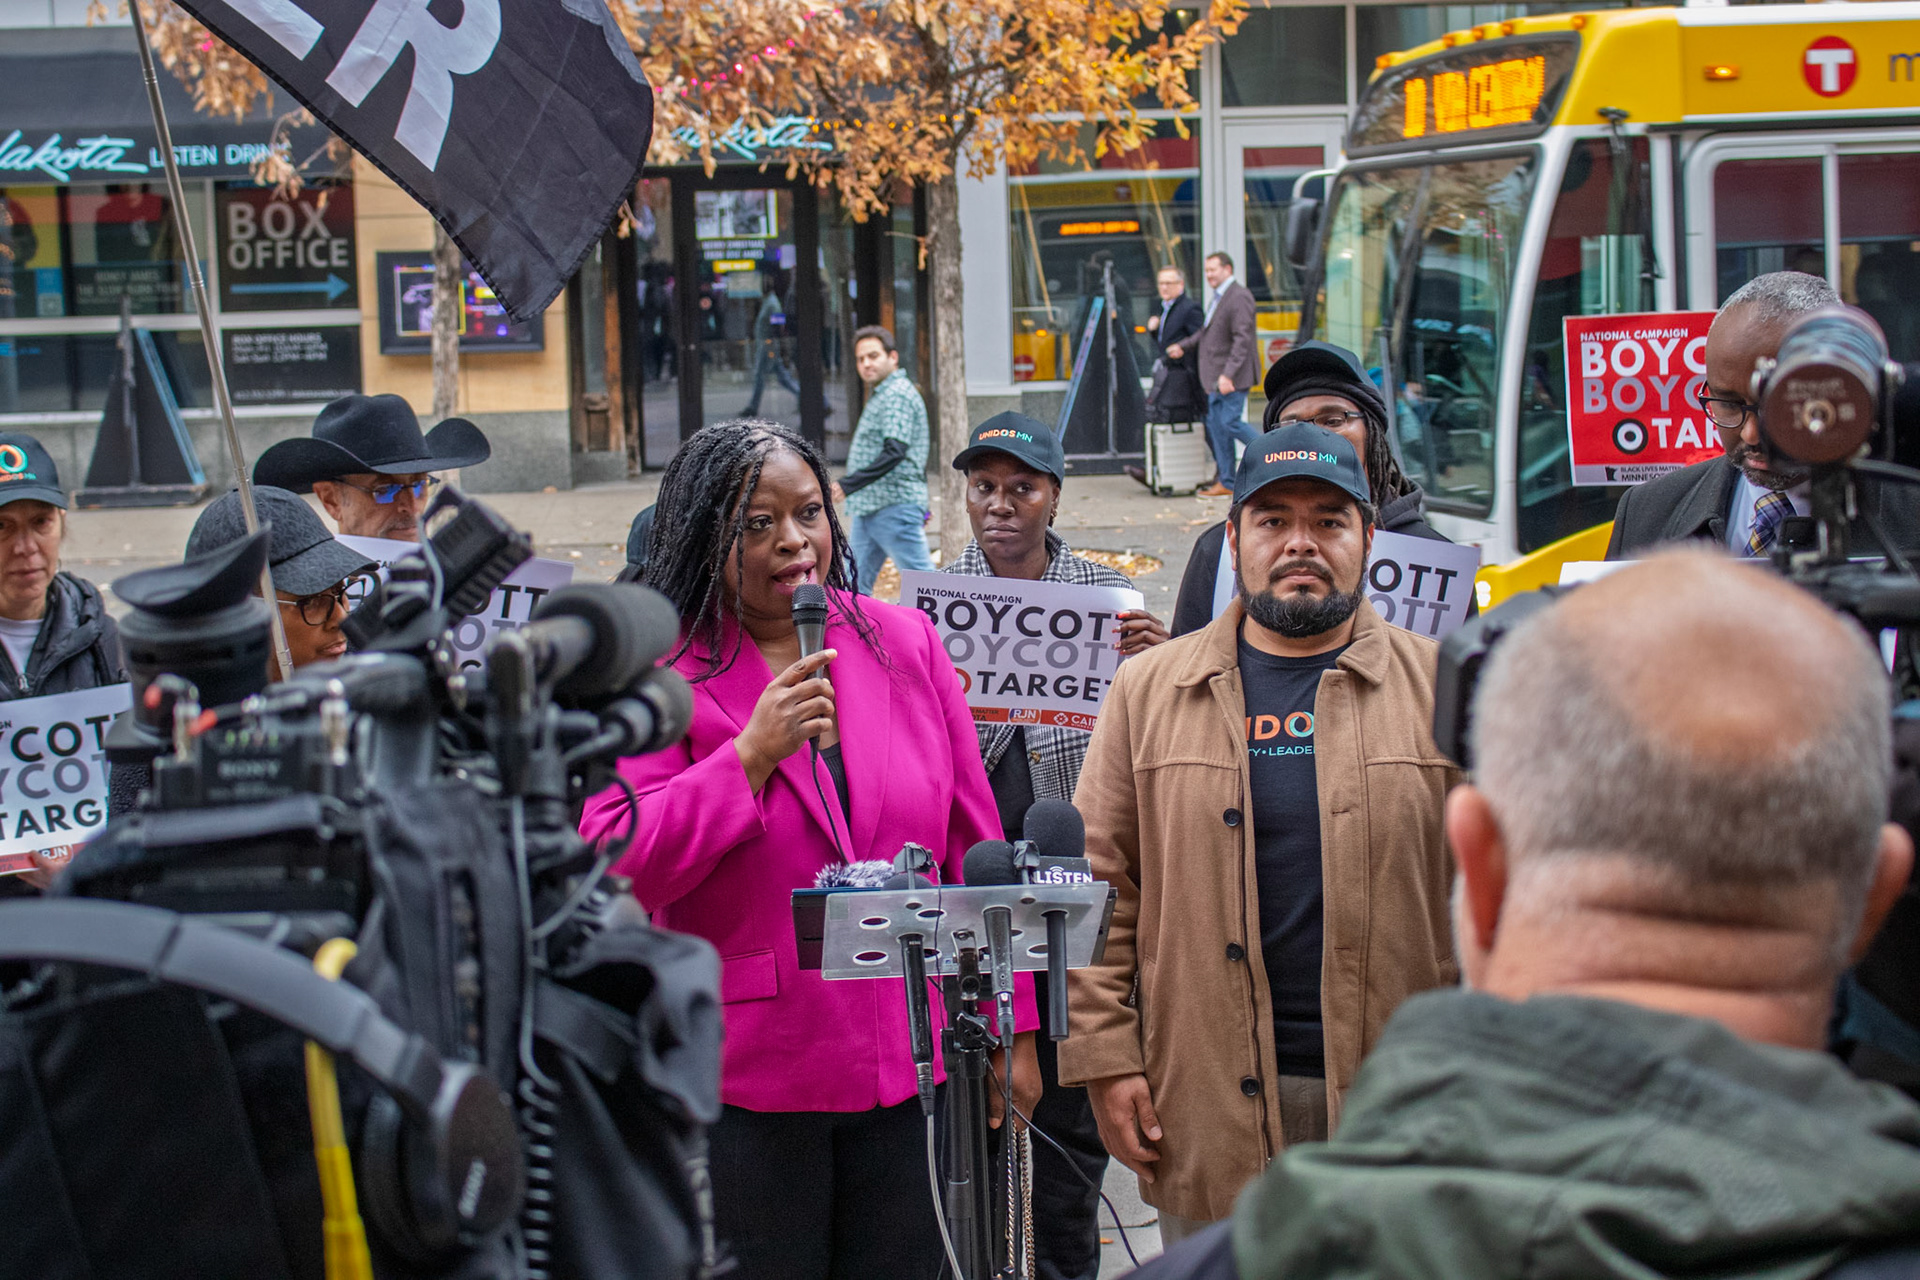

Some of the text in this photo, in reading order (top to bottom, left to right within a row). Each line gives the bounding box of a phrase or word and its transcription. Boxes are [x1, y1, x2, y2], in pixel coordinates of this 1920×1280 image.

[149, 145, 219, 168] LSTEN
[228, 201, 332, 240] BOX
[228, 238, 349, 270] OFFICE
[1580, 328, 1688, 342] NATIONAL CAMPAIGN
[917, 587, 1022, 605] NATIONAL CAMPAIGN
[916, 596, 1130, 645] BOYCOT
[943, 632, 1128, 671] OYCOT
[977, 671, 1111, 702] TARGE
[1014, 709, 1036, 719] RJN
[0, 713, 121, 763] COT
[1269, 746, 1315, 757] LEADE
[1035, 871, 1093, 885] LISTEN
